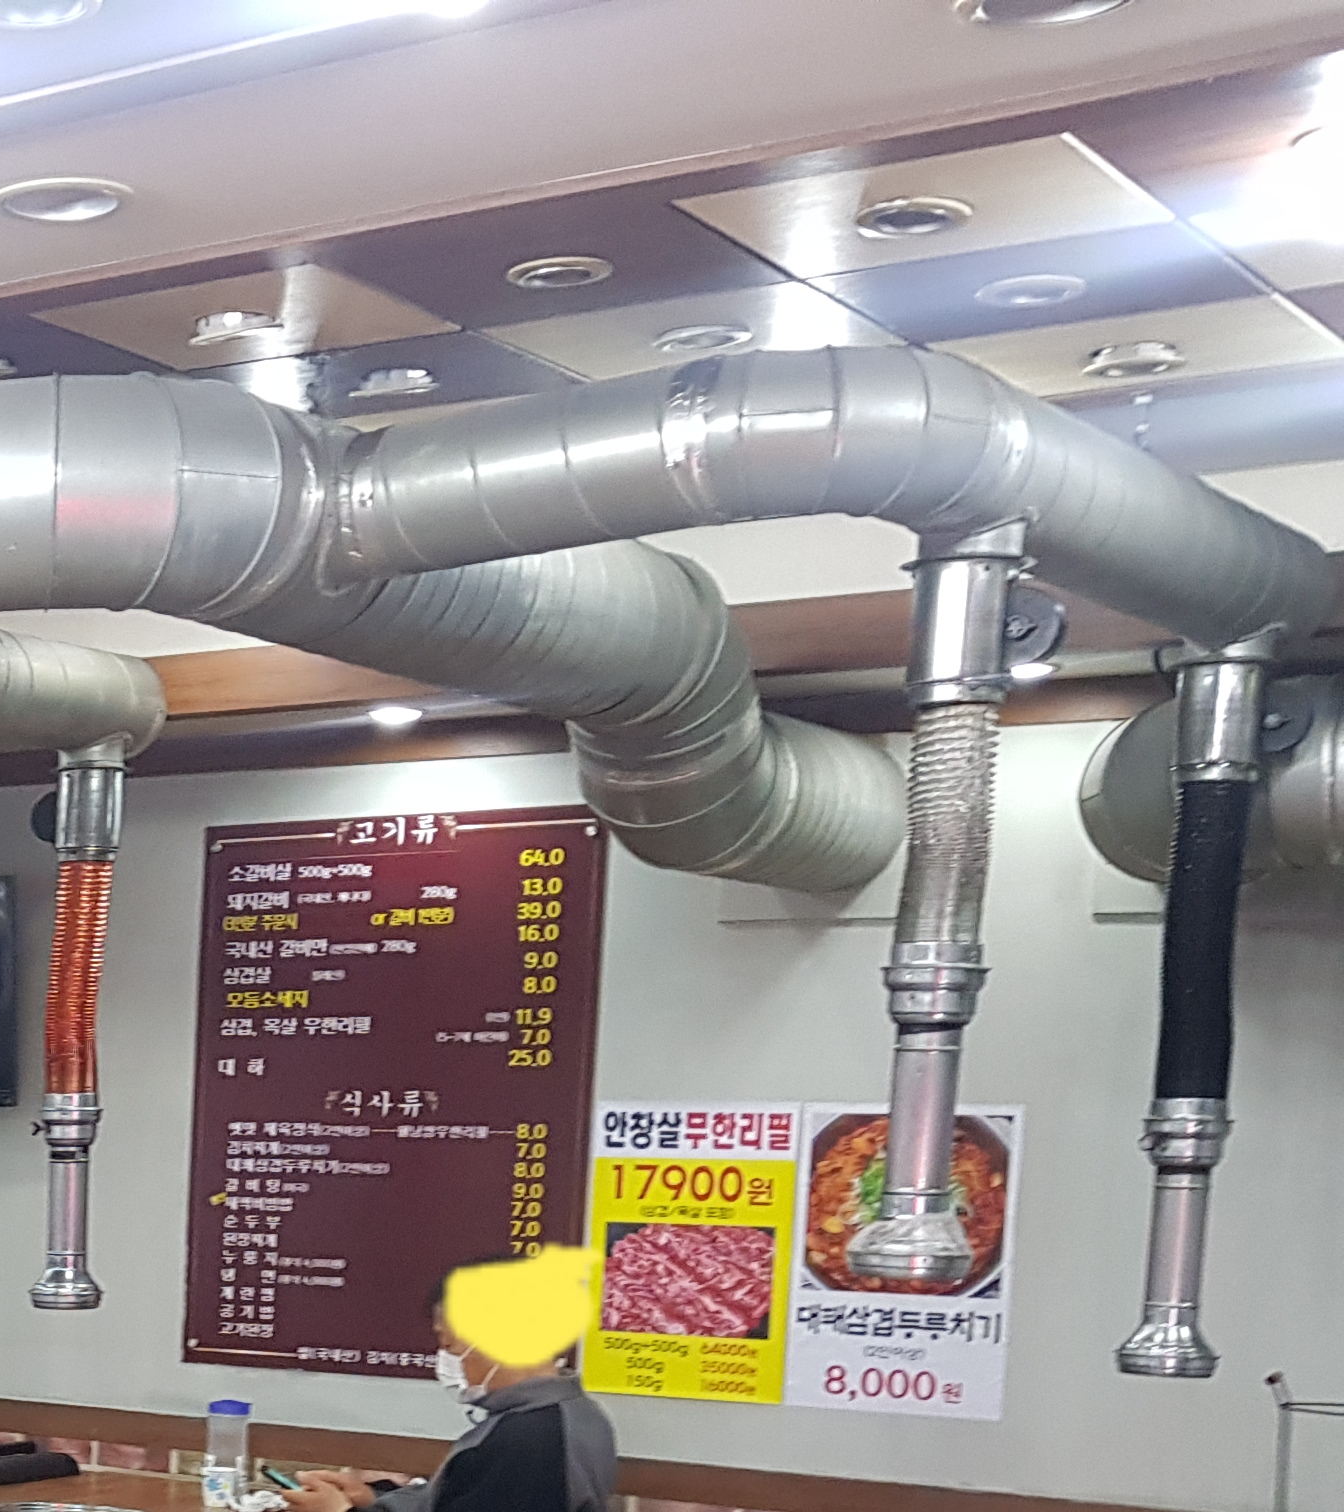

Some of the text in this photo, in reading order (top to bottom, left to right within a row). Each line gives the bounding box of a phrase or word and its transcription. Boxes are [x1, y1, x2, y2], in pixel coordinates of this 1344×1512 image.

[349, 814, 438, 846] 고기류
[519, 848, 565, 867] 64.0
[522, 877, 563, 896] 13.0
[516, 900, 562, 920] 39.0
[518, 923, 560, 942] 16.0
[523, 951, 559, 969] 9.0
[522, 975, 558, 994] 8.0
[520, 1028, 552, 1046] 7.0
[507, 1048, 553, 1068] 25.0
[340, 1090, 424, 1118] 식사류
[515, 1123, 549, 1140] 8.0
[515, 1142, 548, 1160] 7.0
[513, 1162, 546, 1179] 8.0
[512, 1182, 545, 1201] 9.0
[612, 1163, 776, 1207] 17900원
[510, 1201, 543, 1219] 7.0
[510, 1220, 542, 1238] 7.0
[796, 1303, 1003, 1345] 대패삼겹두루치기
[823, 1363, 964, 1405] 8,000원
